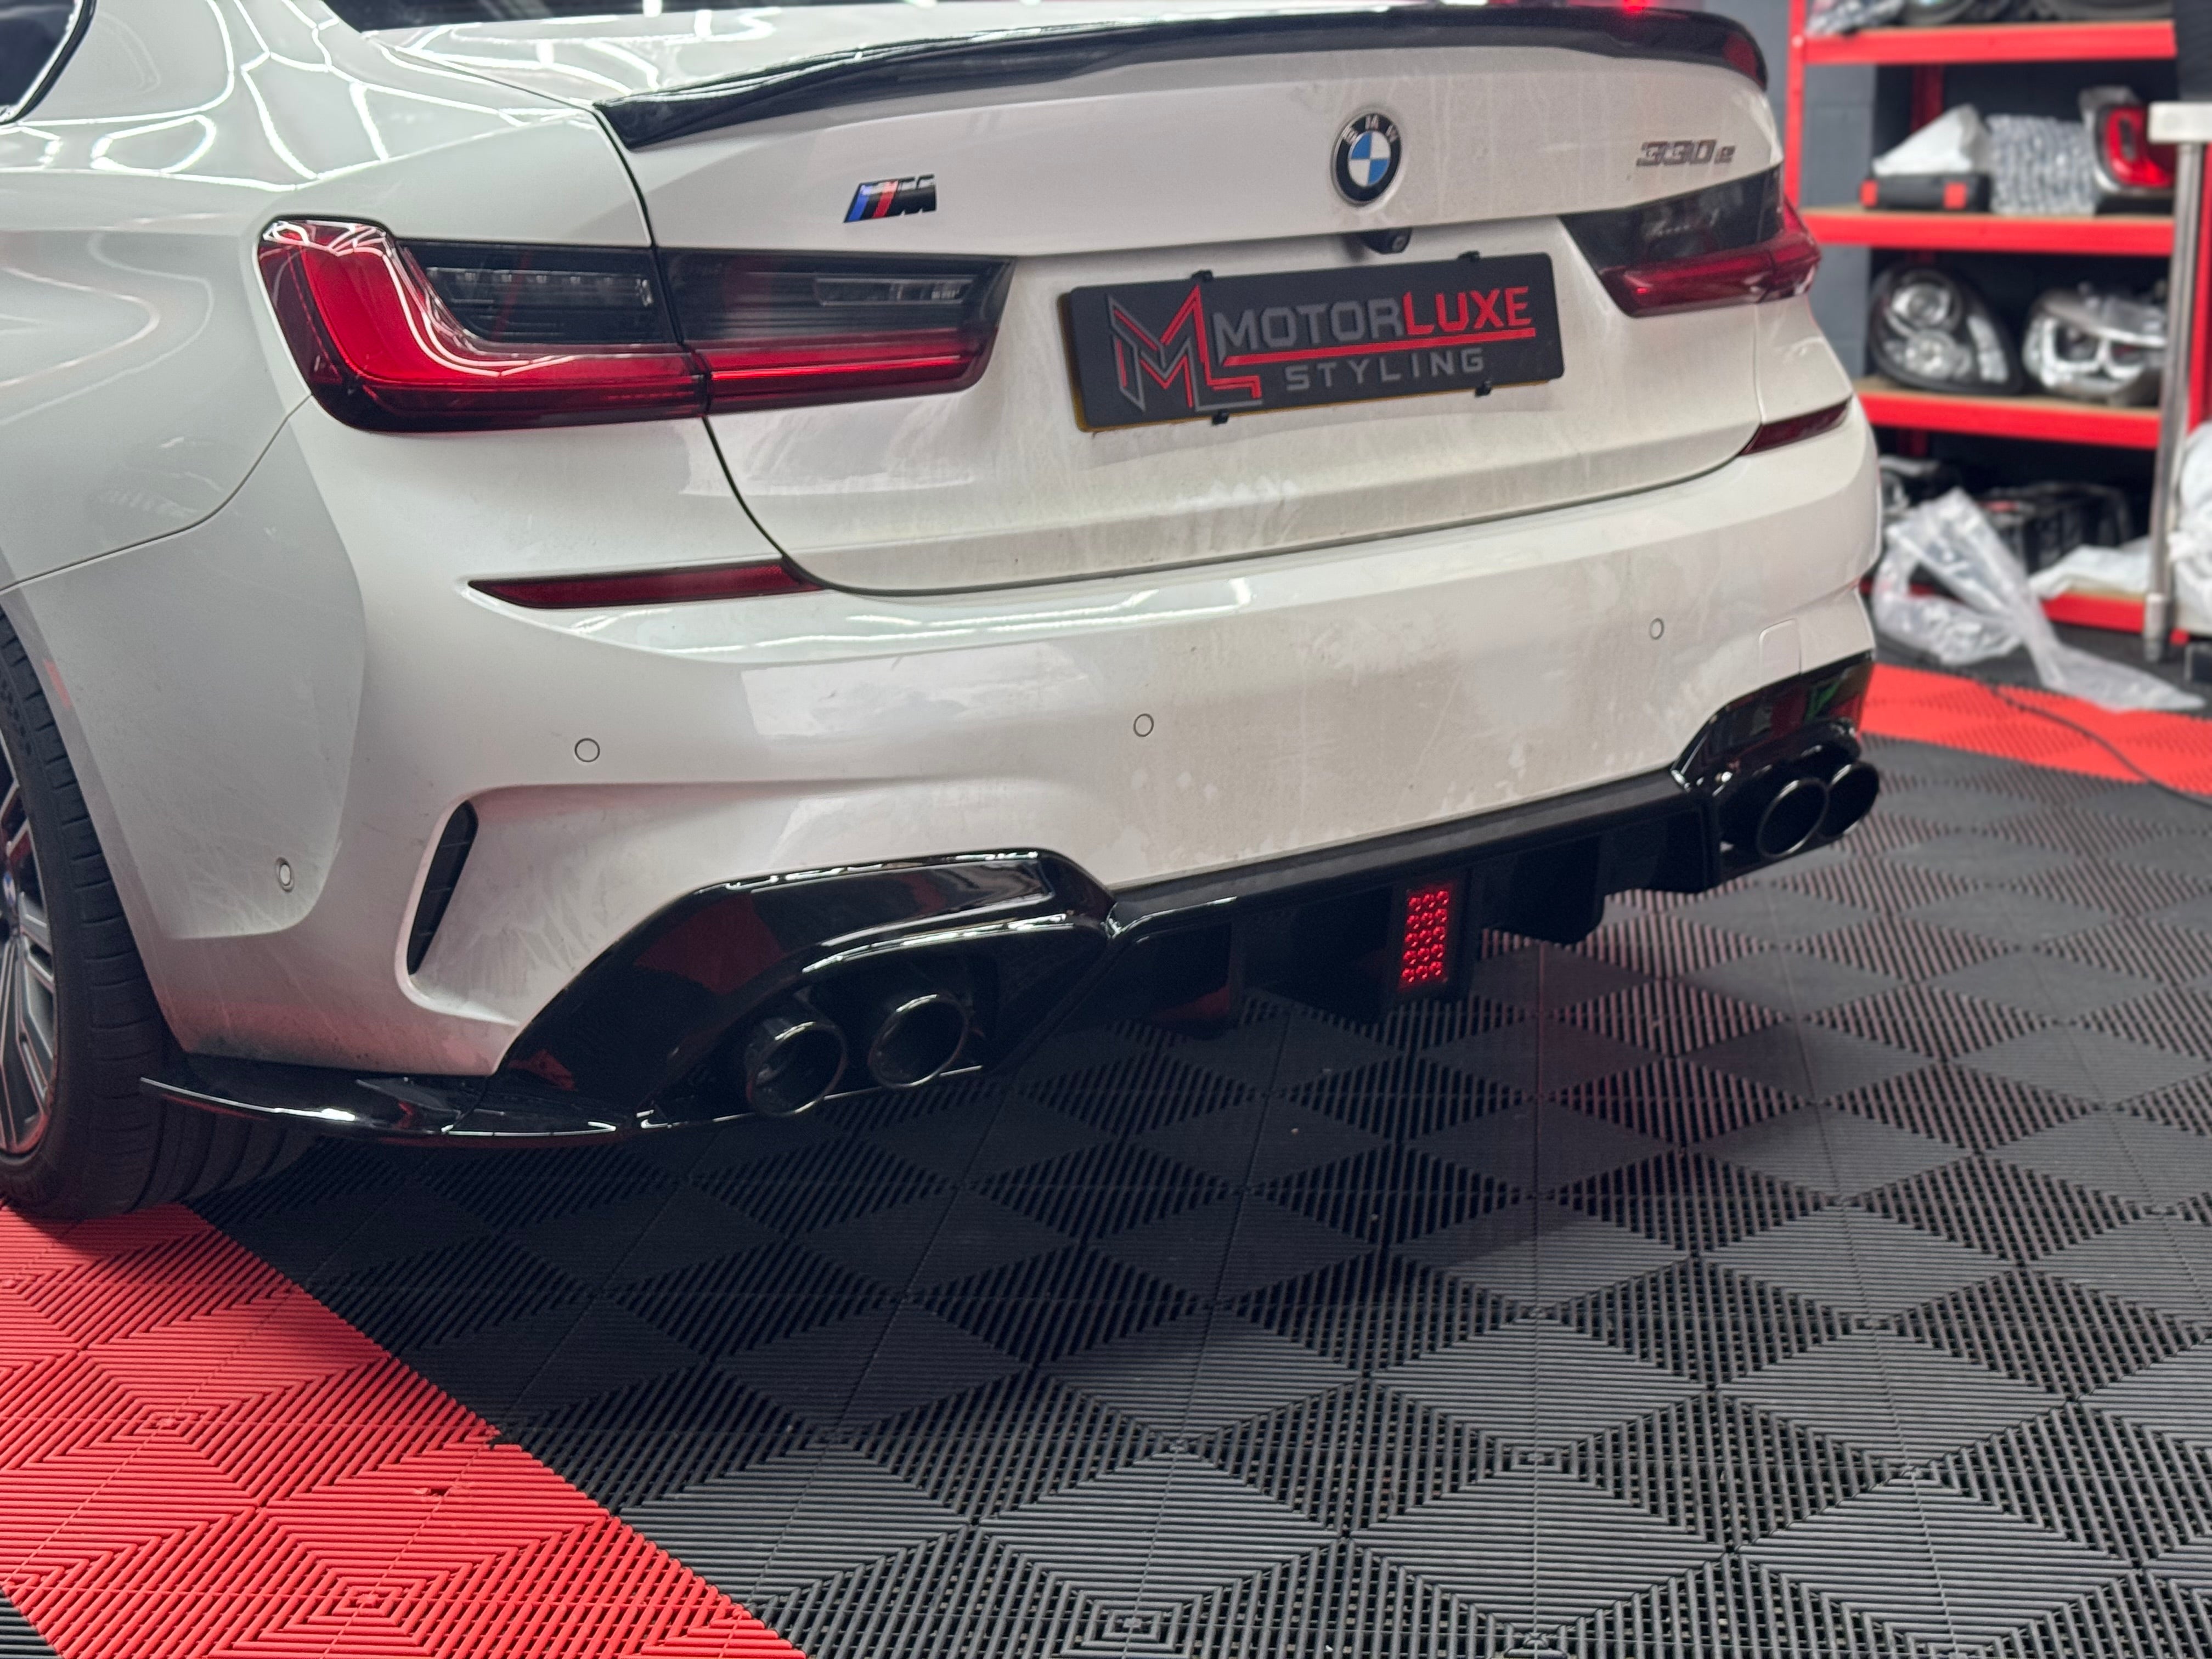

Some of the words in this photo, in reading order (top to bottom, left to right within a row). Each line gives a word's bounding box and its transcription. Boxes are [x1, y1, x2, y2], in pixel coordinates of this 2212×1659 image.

[1635, 139, 1736, 167] 330e
[1212, 285, 1533, 366] MOTORLUXE
[1285, 347, 1485, 391] STYLING
